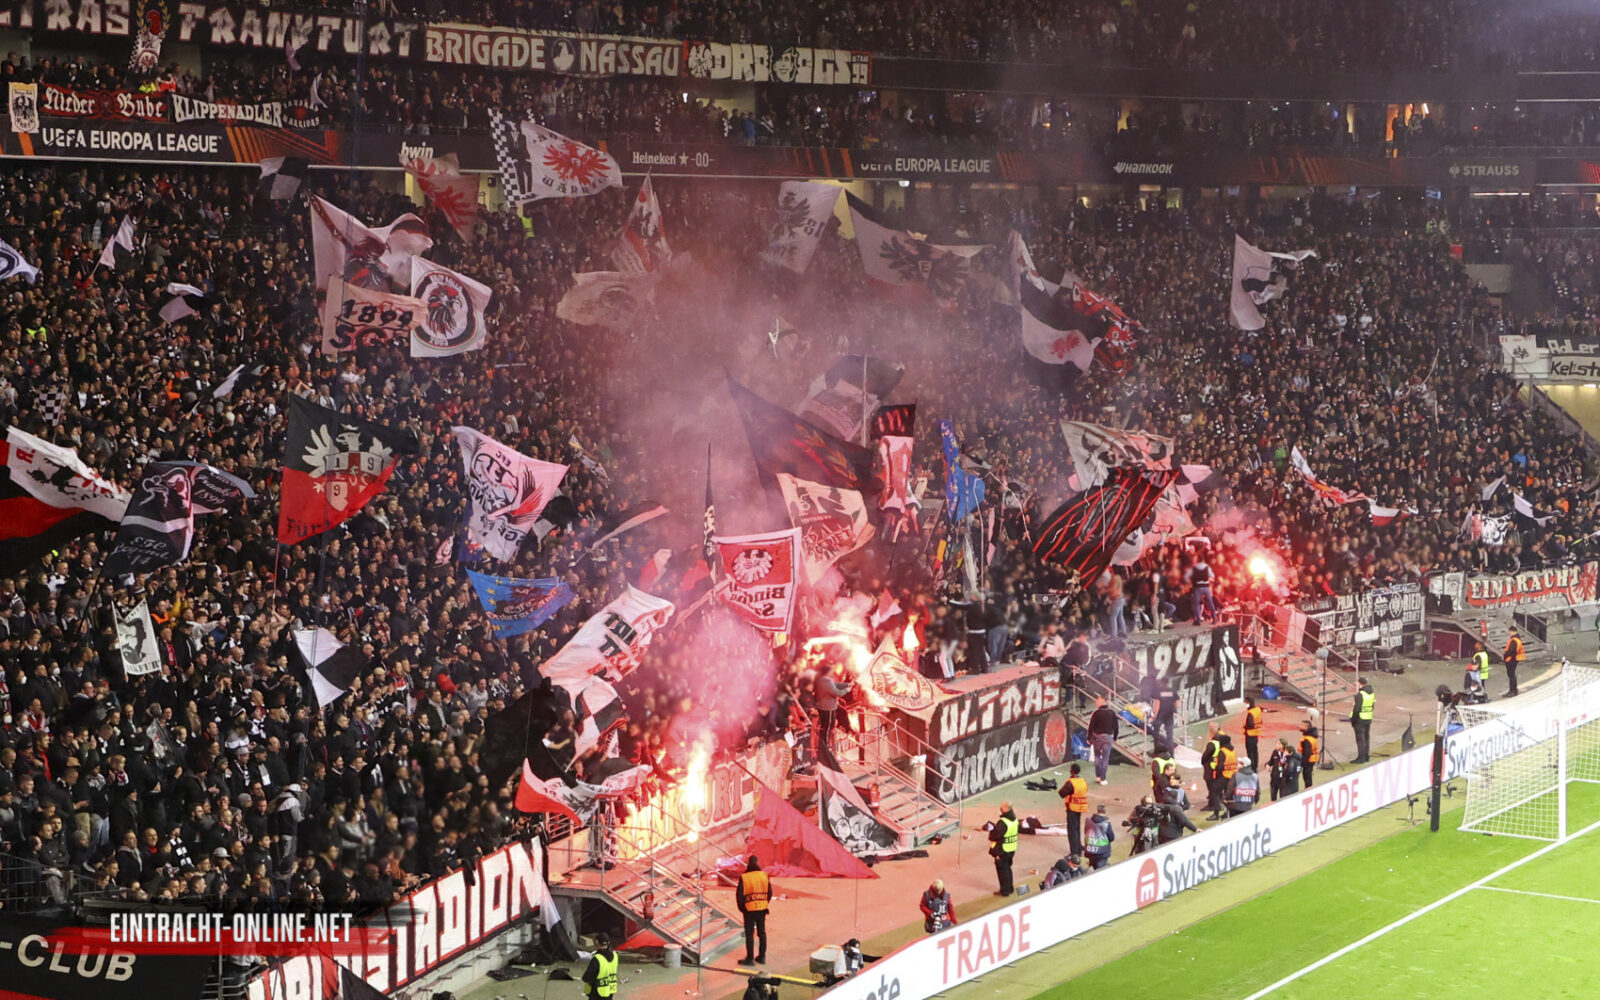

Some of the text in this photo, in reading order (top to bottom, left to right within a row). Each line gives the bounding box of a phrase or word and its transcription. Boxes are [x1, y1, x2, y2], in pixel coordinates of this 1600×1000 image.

[177, 2, 418, 58] FRANKFURT
[426, 28, 680, 77] BRIGADE NASSAU
[172, 94, 283, 129] KLIPPENADLER
[42, 127, 219, 153] UEFA EUROPA LEAGUE
[400, 141, 434, 159] bwin
[632, 151, 677, 165] Heineken
[895, 157, 942, 172] EUROPA
[944, 159, 990, 173] LEAGUE
[1463, 165, 1520, 177] STRAUSS
[1469, 565, 1581, 599] EINTRACHT
[1135, 632, 1213, 683] 1997
[939, 670, 1061, 746] ULTRAS
[938, 720, 1041, 804] Eintracht
[1301, 777, 1360, 833] TRADE
[1162, 822, 1273, 899] Swissquote
[937, 904, 1032, 985] TRADE
